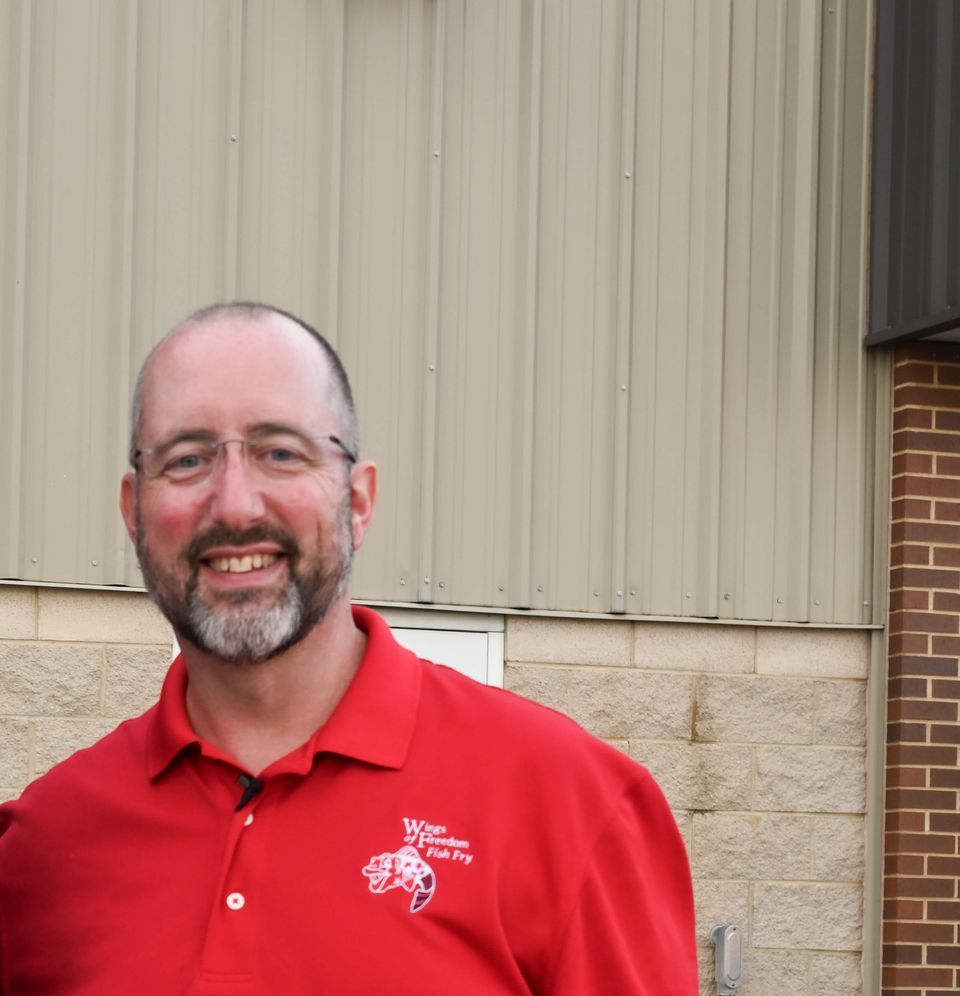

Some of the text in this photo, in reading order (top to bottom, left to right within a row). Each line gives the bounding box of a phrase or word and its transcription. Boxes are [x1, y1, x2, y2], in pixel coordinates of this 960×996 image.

[403, 817, 447, 835] Wings
[417, 831, 470, 849] Freedom
[426, 846, 474, 865] Fish Fry
